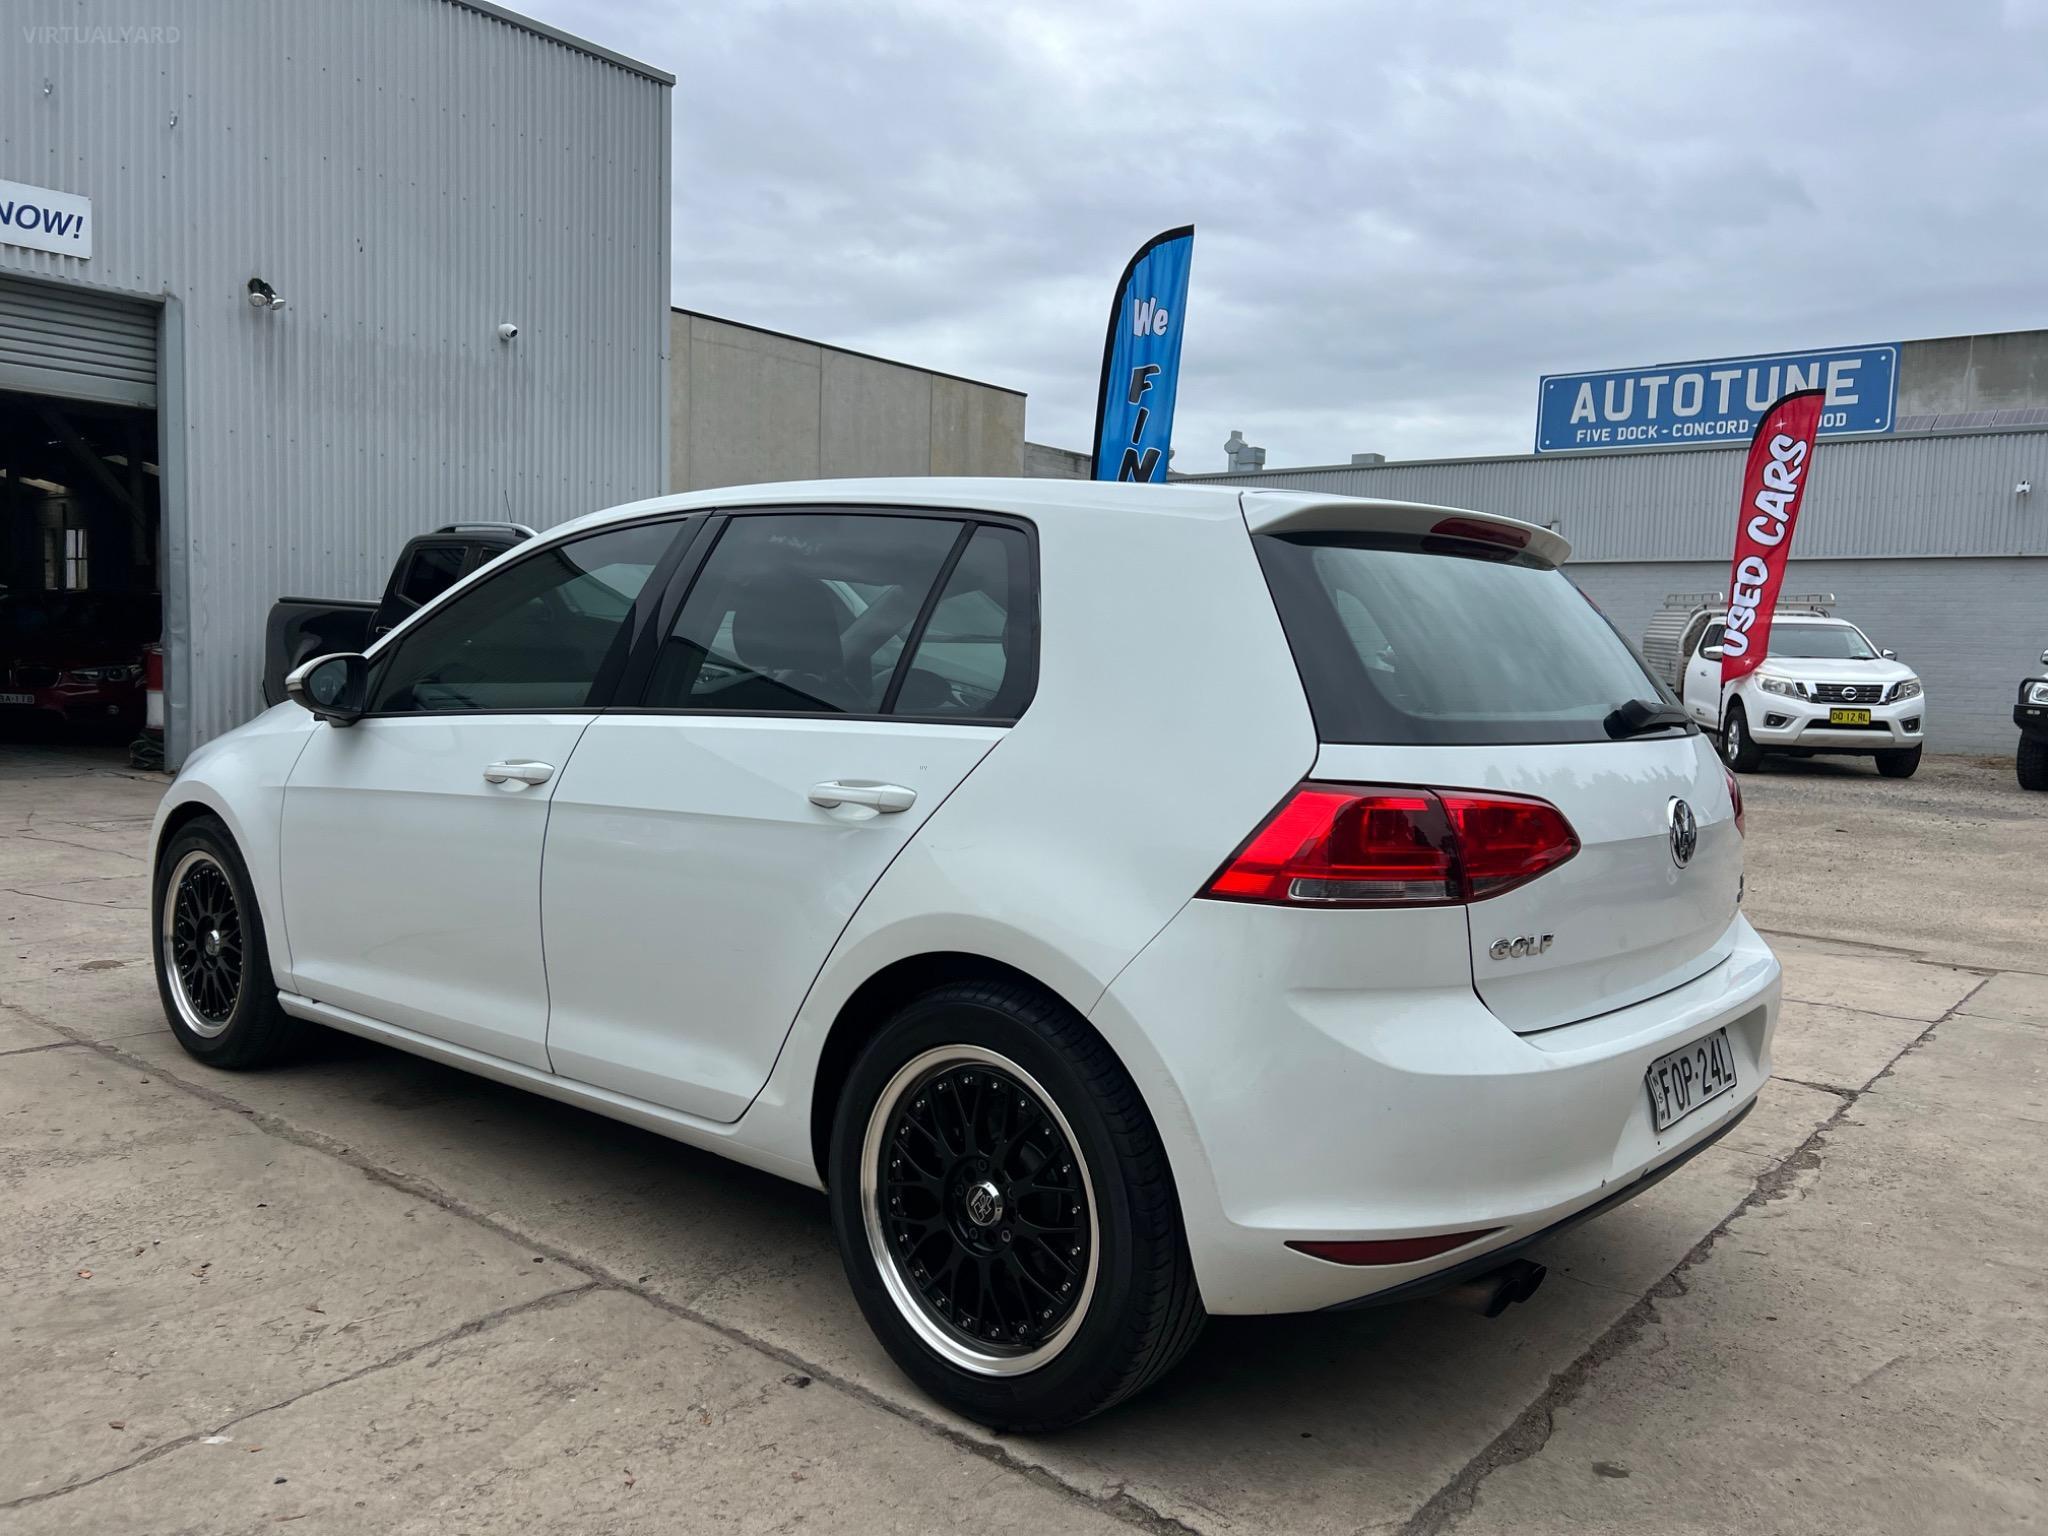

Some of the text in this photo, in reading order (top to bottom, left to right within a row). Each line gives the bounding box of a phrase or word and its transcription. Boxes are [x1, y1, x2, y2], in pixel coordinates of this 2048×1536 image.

[1133, 297, 1169, 336] We
[1570, 359, 1862, 425] AUTOTUNE
[1576, 428, 1611, 443] FIVE
[1616, 425, 1658, 441] DOCK
[1672, 419, 1749, 437] CONCORD
[1723, 433, 1807, 657] USED CARS
[1489, 933, 1554, 960] GOLF
